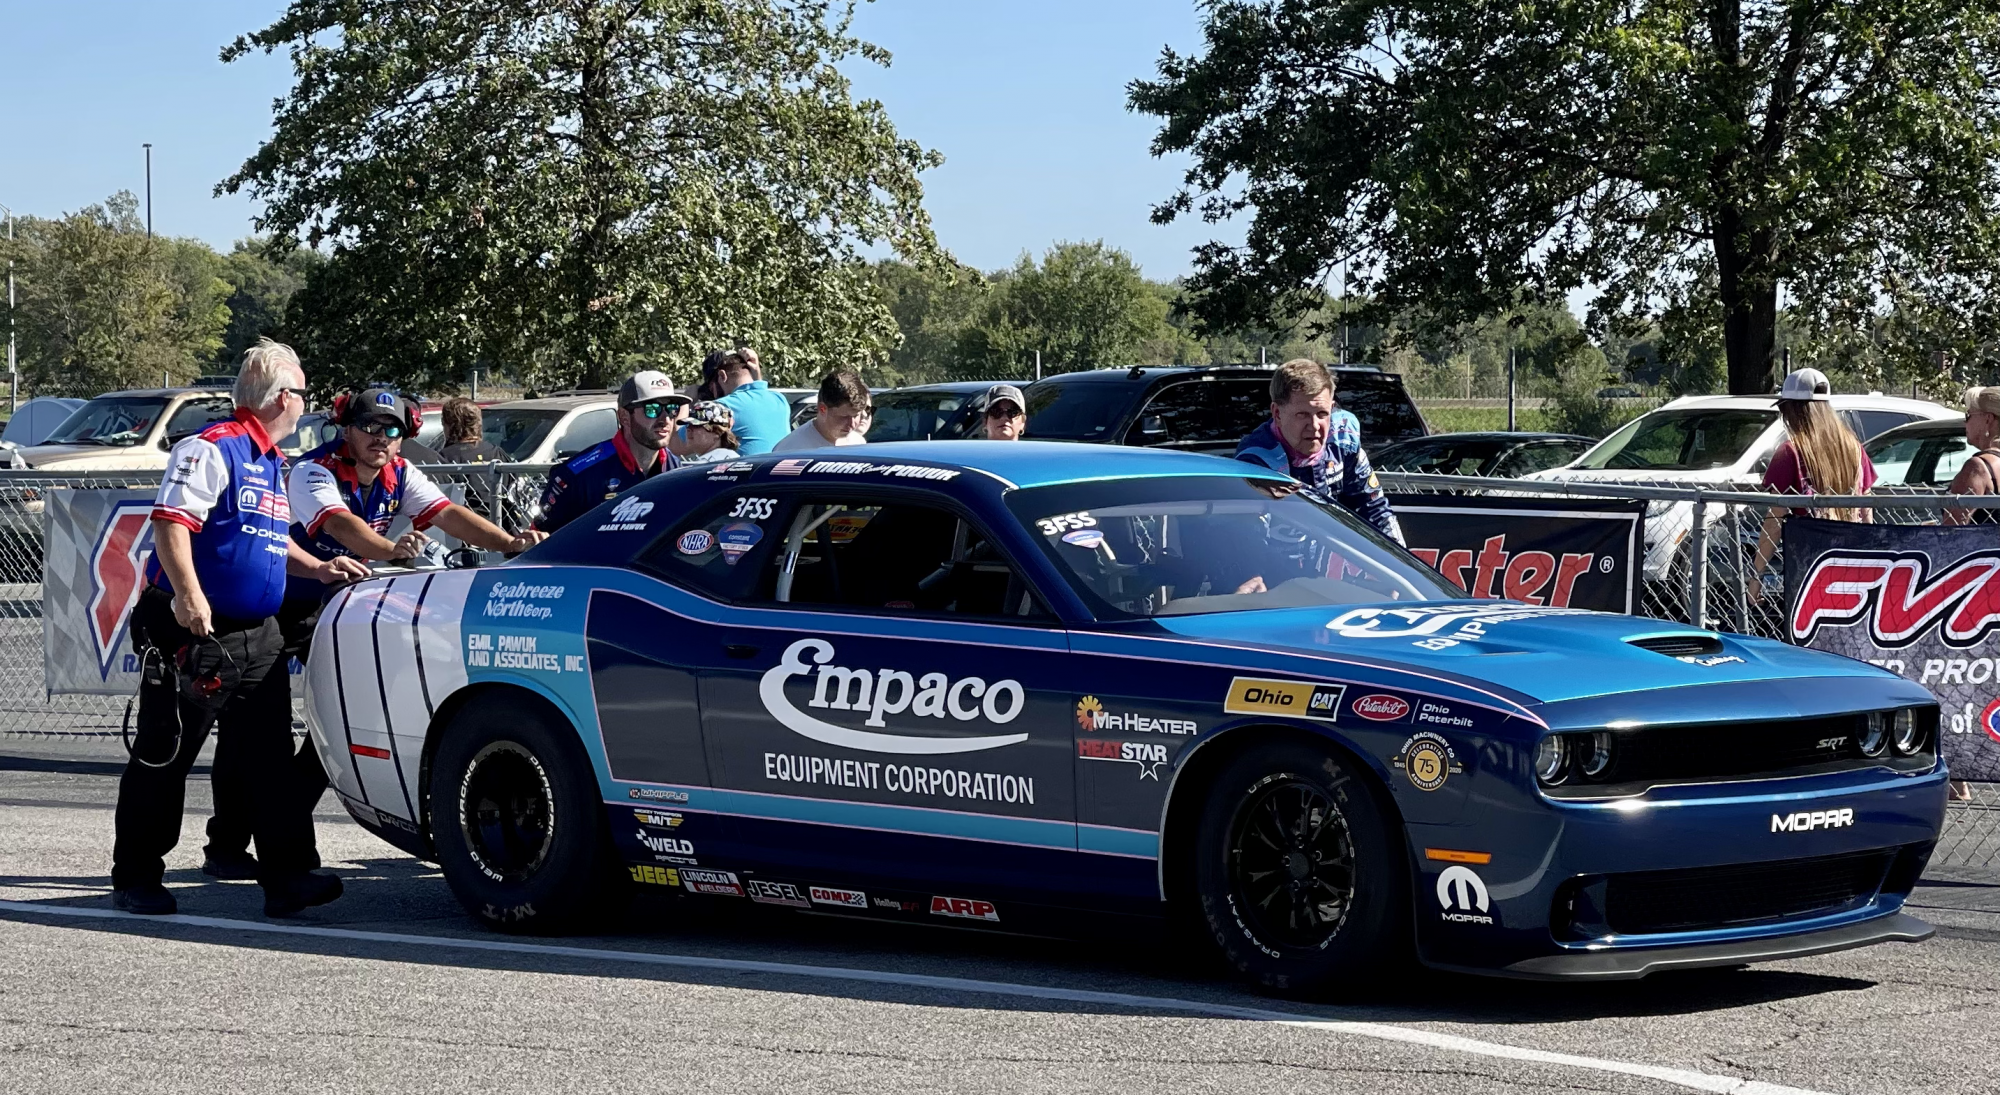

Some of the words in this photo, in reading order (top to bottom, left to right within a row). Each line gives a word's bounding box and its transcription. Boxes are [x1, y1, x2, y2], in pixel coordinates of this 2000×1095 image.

[728, 497, 778, 520] 3FSS
[597, 523, 619, 532] MARK
[620, 523, 647, 531] PAWUK
[1038, 511, 1097, 536] 3FSS
[683, 533, 709, 551] NHRA
[1409, 534, 1594, 608] ster
[489, 581, 565, 599] Seabreeze
[468, 633, 494, 651] EMIL
[498, 635, 537, 652] PAWUK
[468, 651, 490, 667] AND
[494, 652, 561, 673] ASSOCIATES,
[565, 655, 584, 671] INC
[1920, 658, 2000, 685] PRO
[759, 638, 1029, 748] Empaco
[1244, 688, 1294, 706] Ohio
[1311, 692, 1339, 710] CAT
[1357, 697, 1407, 716] Peterbilt
[1421, 703, 1450, 714] Ohio
[1419, 713, 1474, 728] Peterbilt
[1951, 703, 1974, 734] of
[1401, 738, 1413, 754] OHIO
[1413, 731, 1450, 748] MACHINERY
[1447, 747, 1455, 758] CO
[1411, 743, 1445, 760] CELEBRATING
[1816, 736, 1848, 750] SRT
[1418, 758, 1434, 774] 75
[764, 752, 880, 790] EQUIPMENT
[884, 763, 1035, 805] CORPORATION
[1411, 773, 1443, 788] ANNIVERSARY
[459, 759, 477, 826] RACING
[641, 788, 689, 800] WHIPPLE
[647, 814, 673, 826] M/T
[1771, 808, 1854, 832] MOPAR
[648, 837, 694, 855] WELD
[470, 851, 503, 883] WELD
[628, 865, 680, 887] JEGS
[681, 870, 730, 885] LINCOLN
[698, 884, 740, 895] WELDERS
[747, 879, 806, 902] JESEL
[812, 888, 852, 902] COMP
[873, 896, 902, 911] Holley
[931, 897, 996, 917] ARP
[1441, 912, 1494, 925] MOPAR
